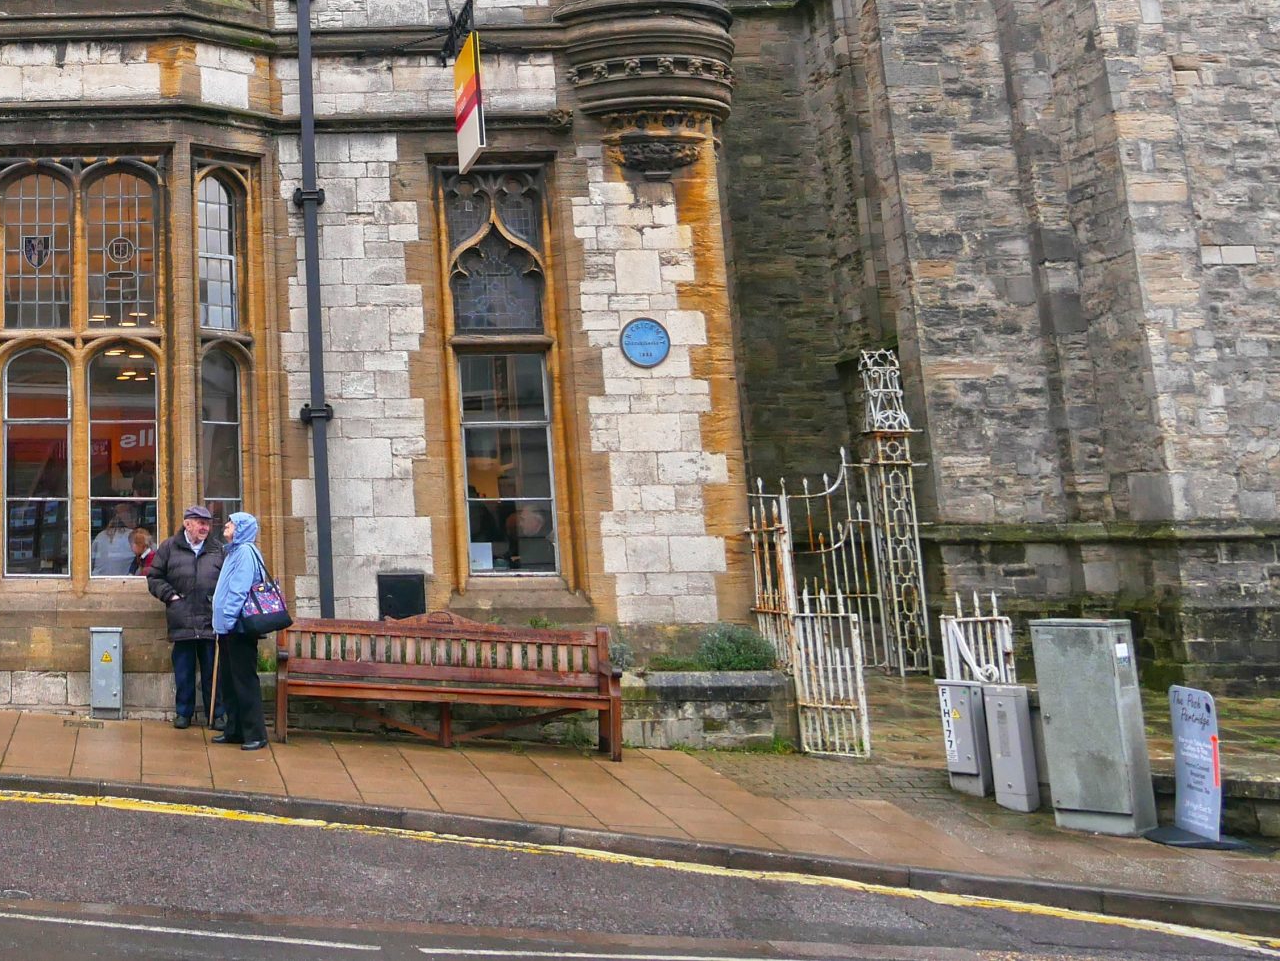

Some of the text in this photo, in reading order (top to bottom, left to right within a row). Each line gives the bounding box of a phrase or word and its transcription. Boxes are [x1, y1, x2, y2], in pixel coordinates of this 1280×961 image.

[1172, 690, 1201, 709] The Posh
[1181, 707, 1210, 731] Partridge
